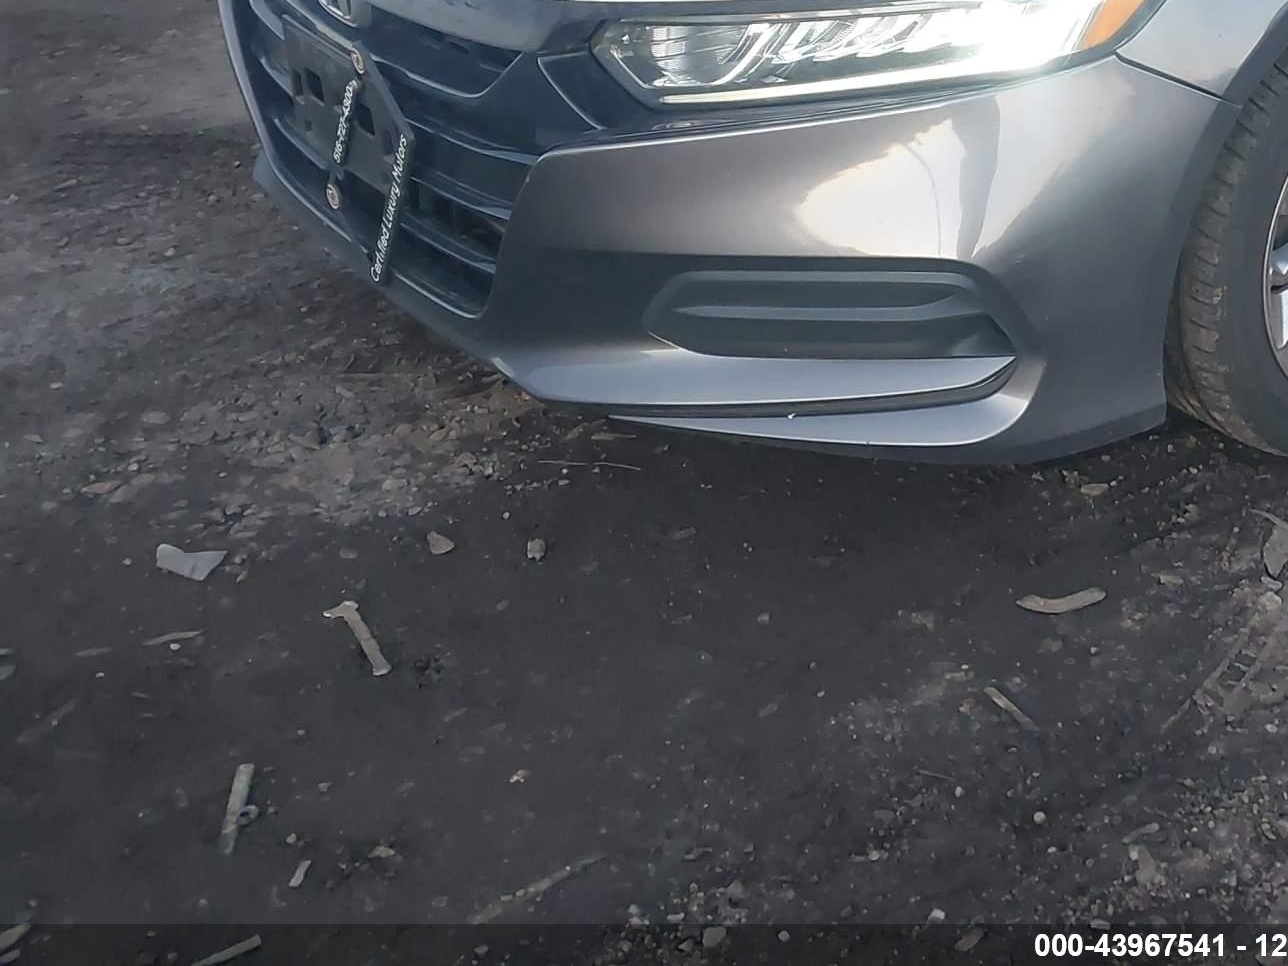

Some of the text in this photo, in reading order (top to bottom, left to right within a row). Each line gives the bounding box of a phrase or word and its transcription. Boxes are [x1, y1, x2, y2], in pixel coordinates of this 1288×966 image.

[371, 134, 407, 282] Certified Luxury Motors
